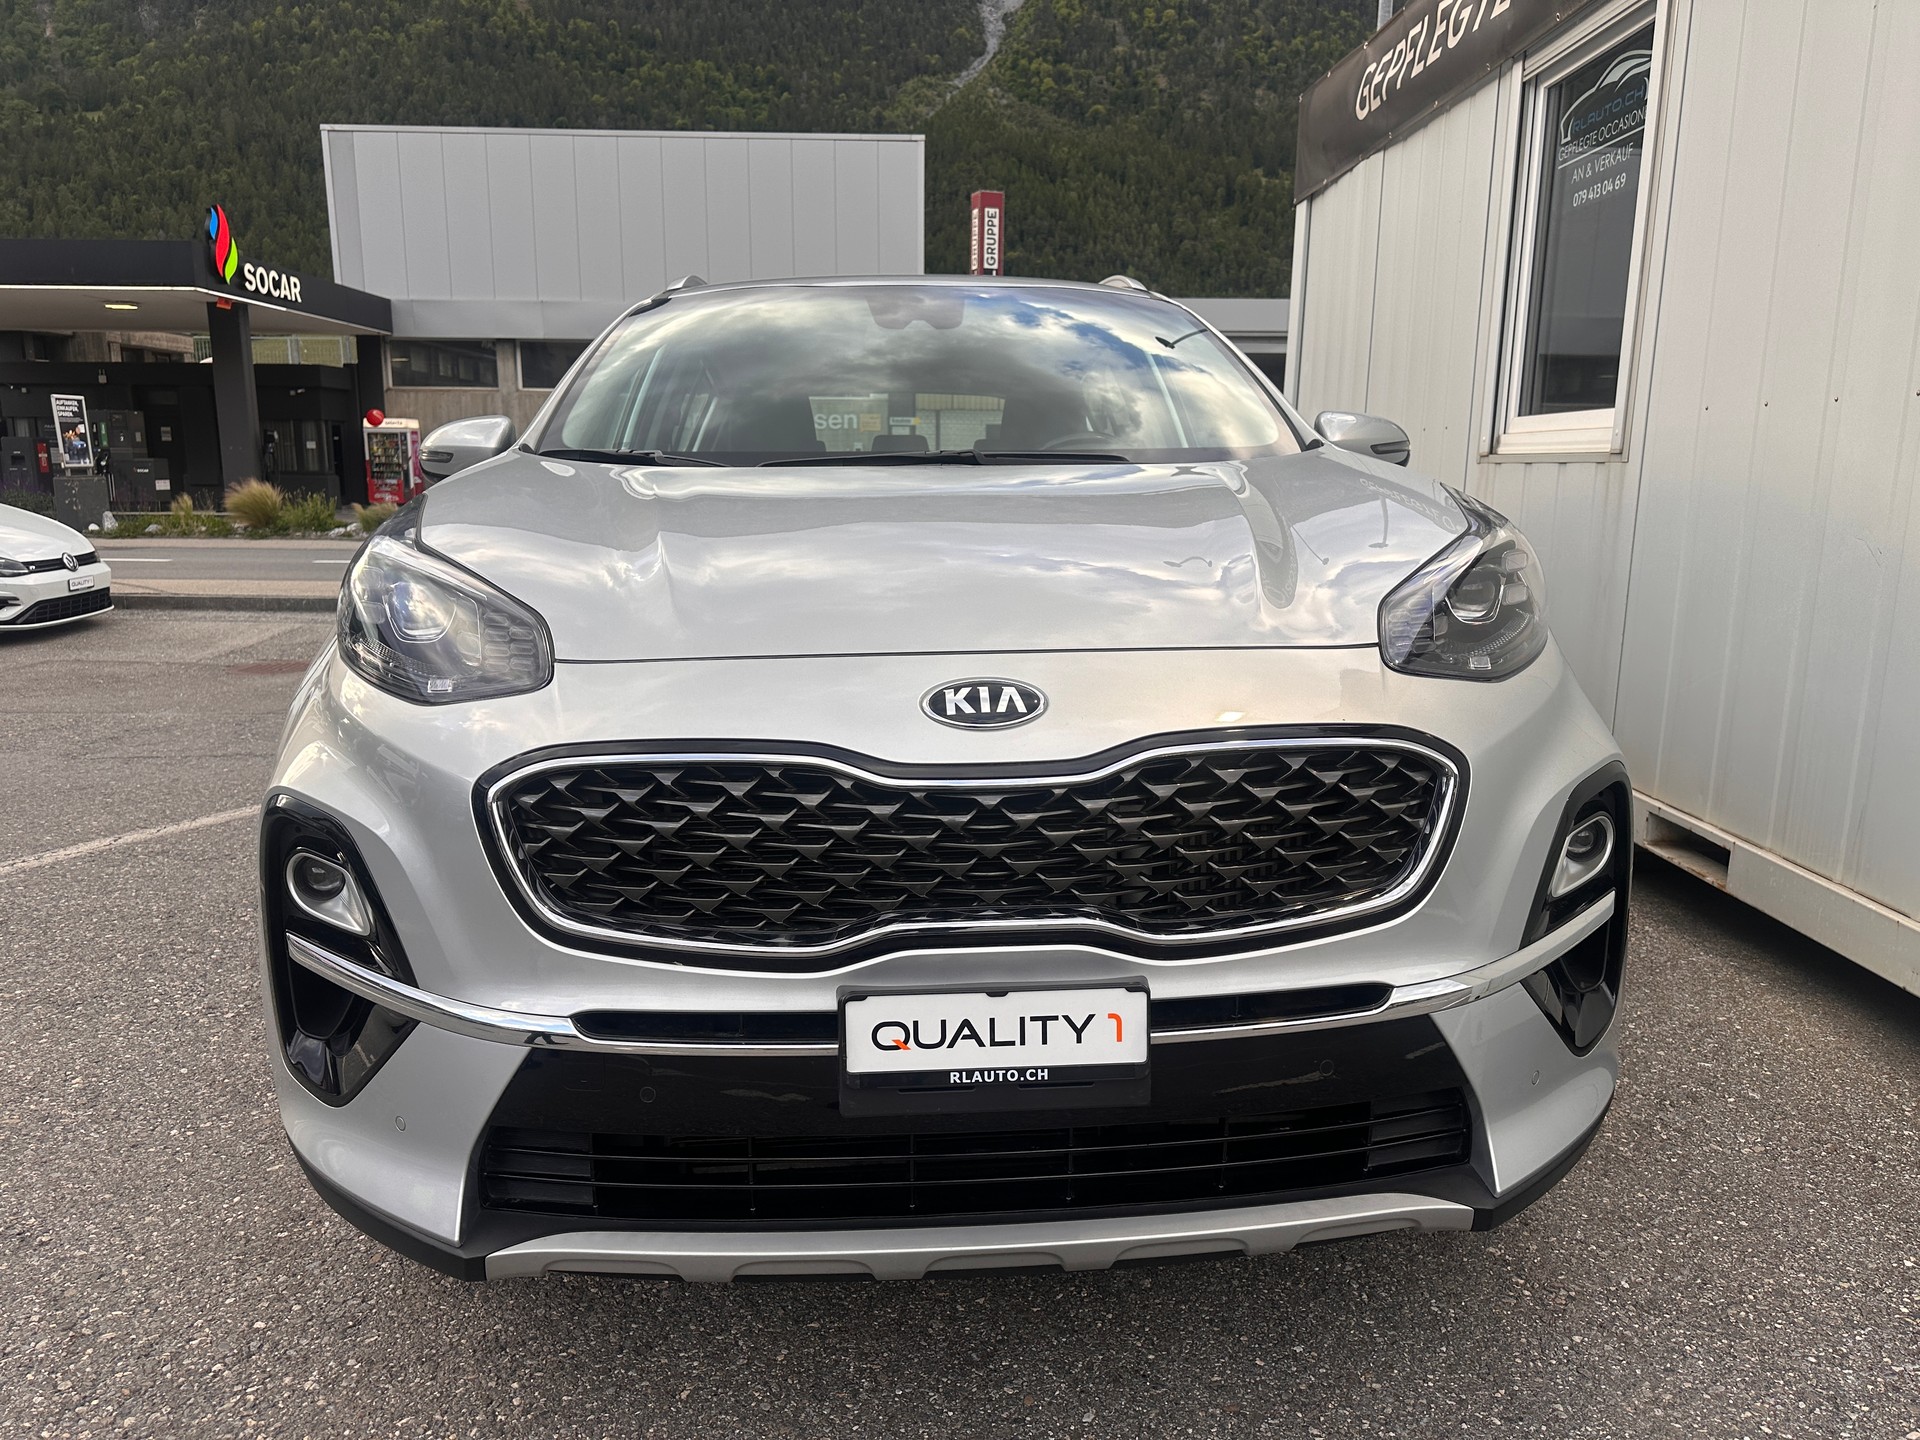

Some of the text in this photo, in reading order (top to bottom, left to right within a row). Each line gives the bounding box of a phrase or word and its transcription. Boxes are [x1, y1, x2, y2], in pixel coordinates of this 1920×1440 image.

[1355, 0, 1511, 121] GEPFLEG
[1572, 85, 1645, 133] RLAUTO.CH
[1559, 131, 1598, 161] GEPFLEGTE
[1571, 142, 1634, 184] AN & VERKAUF
[1572, 172, 1627, 207] 079 413 04 69
[986, 210, 997, 267] GRUPPE
[243, 262, 302, 303] SOCAR
[943, 686, 1028, 716] KIA
[871, 1012, 1123, 1051] QUALITY 1
[949, 1068, 1049, 1084] RLAUTO.CH
